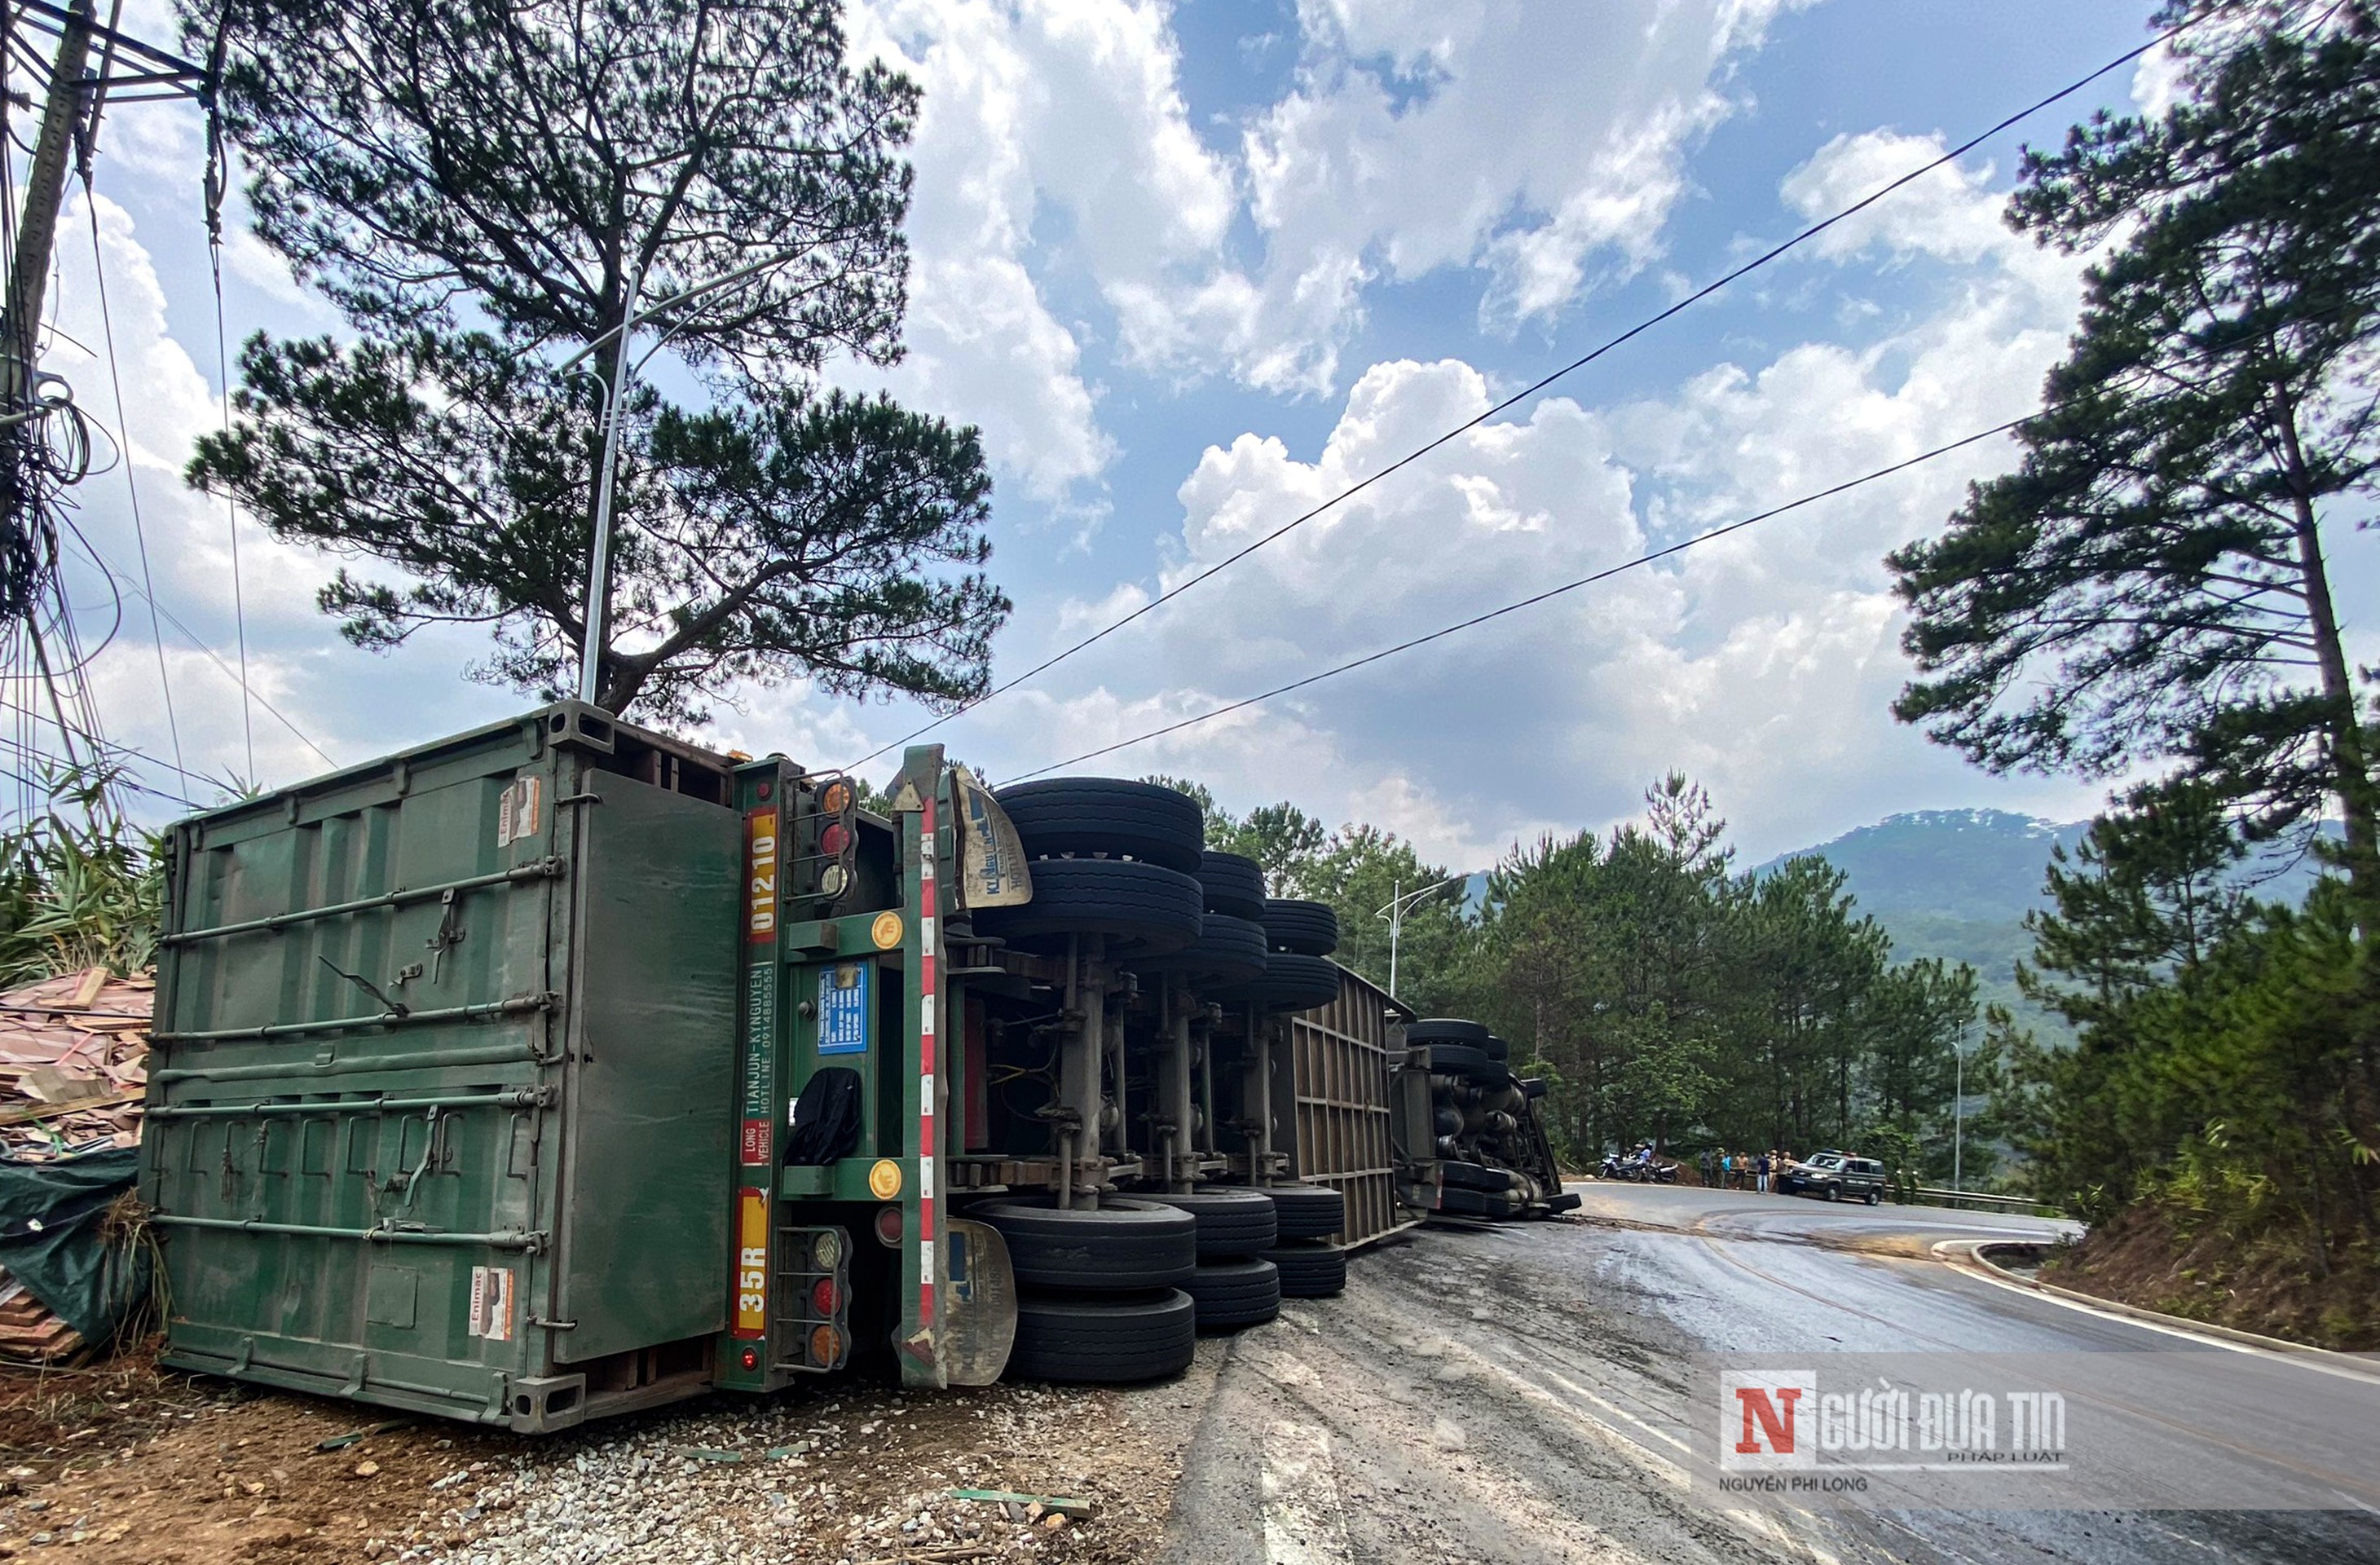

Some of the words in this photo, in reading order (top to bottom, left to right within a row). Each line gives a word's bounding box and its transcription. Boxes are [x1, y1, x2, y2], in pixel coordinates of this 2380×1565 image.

[751, 835, 776, 930] 01210
[981, 837, 999, 895] KYNGUN
[747, 970, 762, 1114] TIANJUN-KYNGUYEN
[745, 1128, 756, 1152] LONG
[758, 1122, 769, 1160] VEHICLE
[471, 1272, 482, 1321] Enimac
[739, 1247, 766, 1313] 35R
